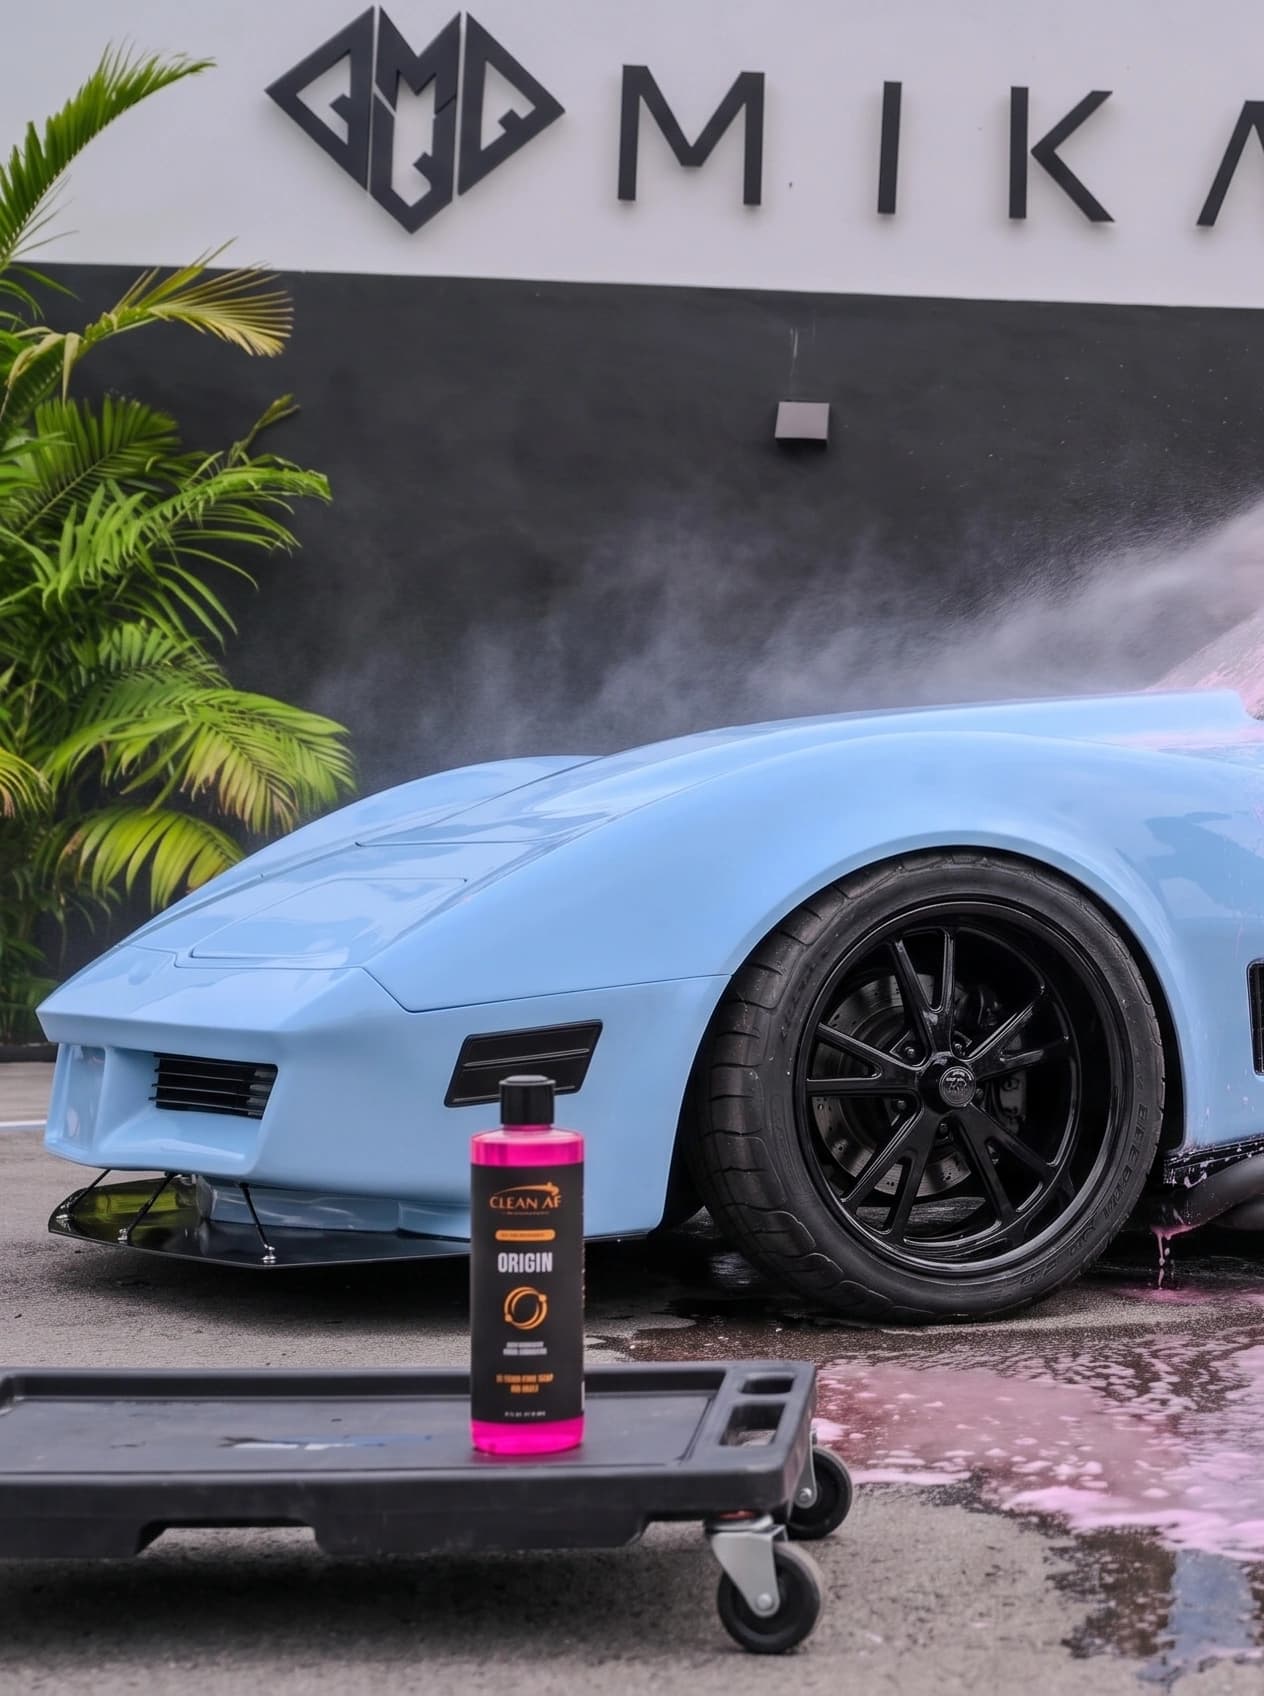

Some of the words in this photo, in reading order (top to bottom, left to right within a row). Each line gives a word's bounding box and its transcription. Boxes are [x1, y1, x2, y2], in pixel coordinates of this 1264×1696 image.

[489, 1195, 538, 1209] CLEAN
[542, 1194, 562, 1209] AF
[498, 1252, 553, 1273] ORIGIN
